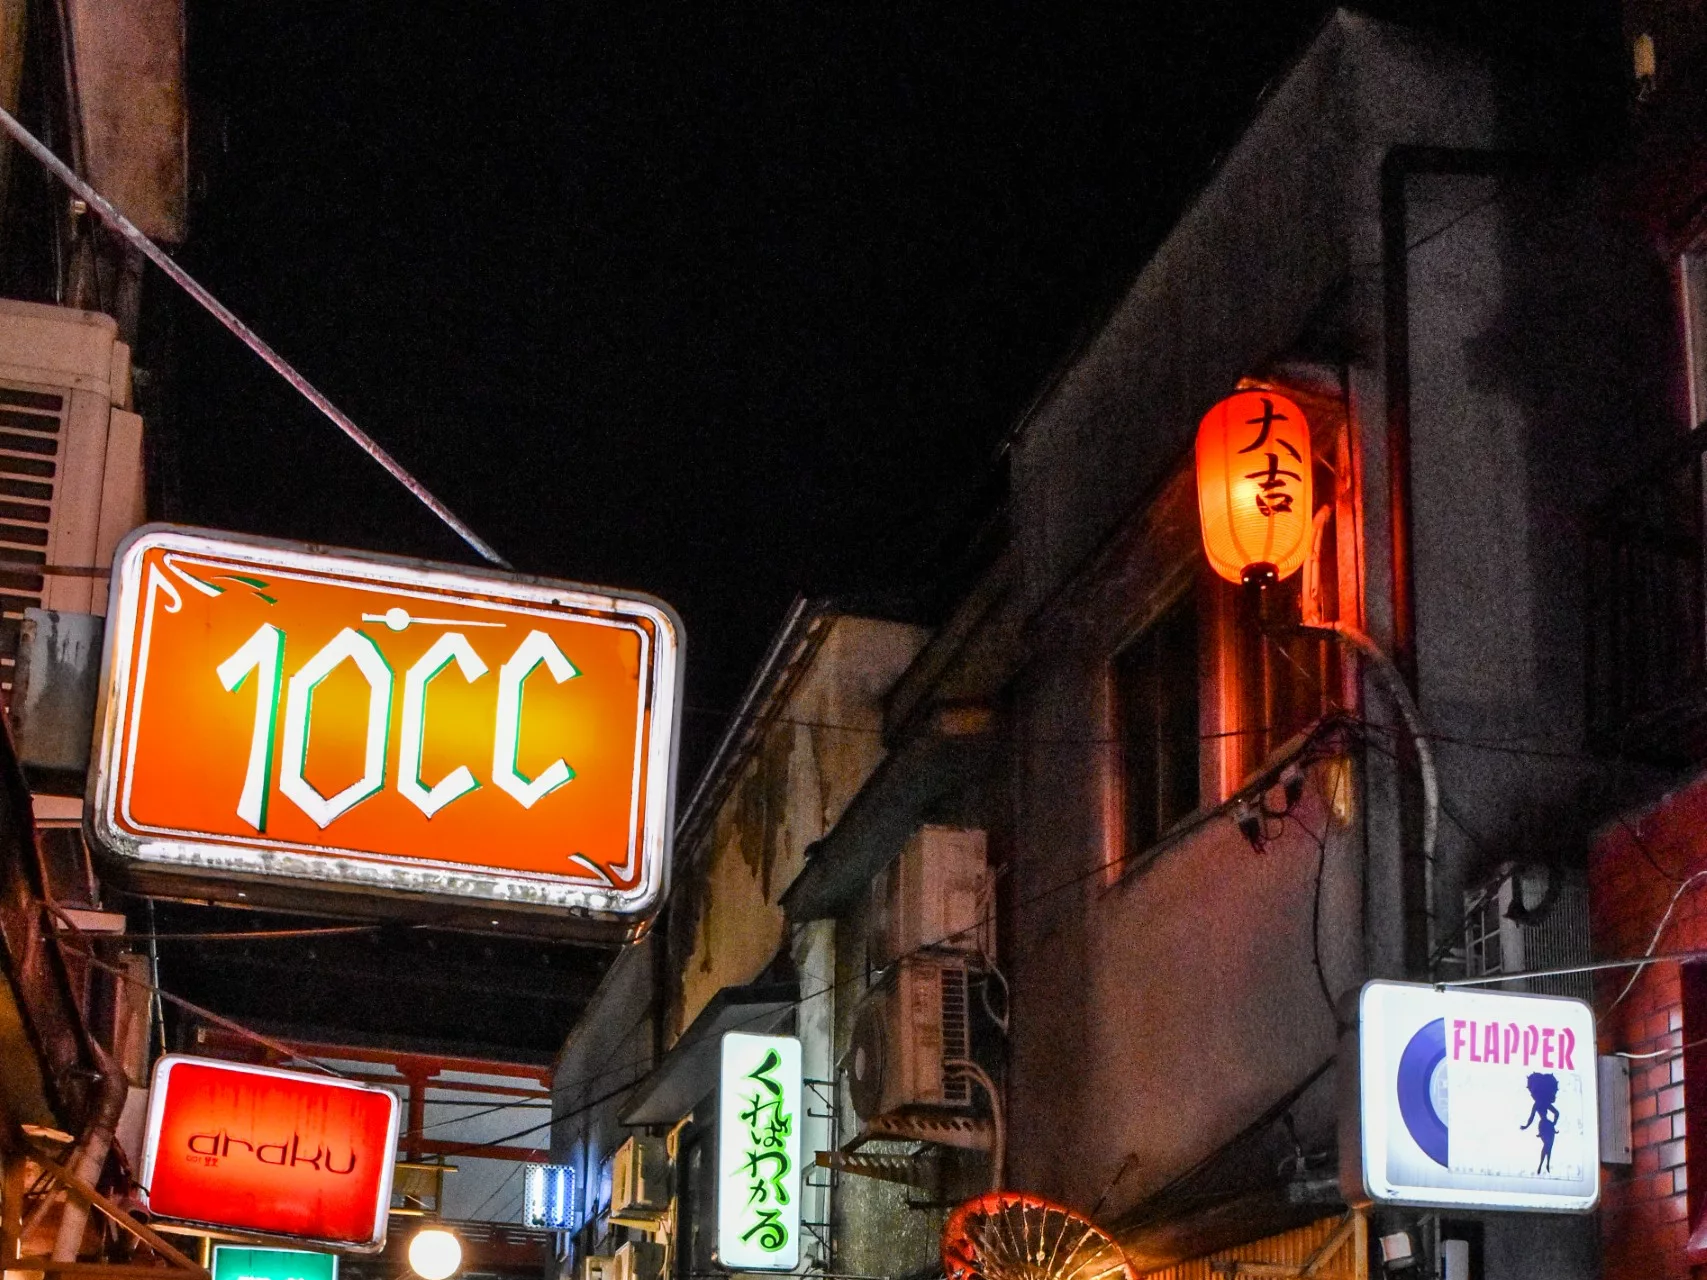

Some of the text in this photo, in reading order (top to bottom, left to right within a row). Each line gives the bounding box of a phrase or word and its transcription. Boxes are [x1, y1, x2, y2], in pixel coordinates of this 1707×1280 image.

[1237, 398, 1303, 517] 大吉
[1453, 1018, 1576, 1071] FLAPPER
[188, 1131, 357, 1175] araku
[739, 1050, 790, 1250] くればわかる
